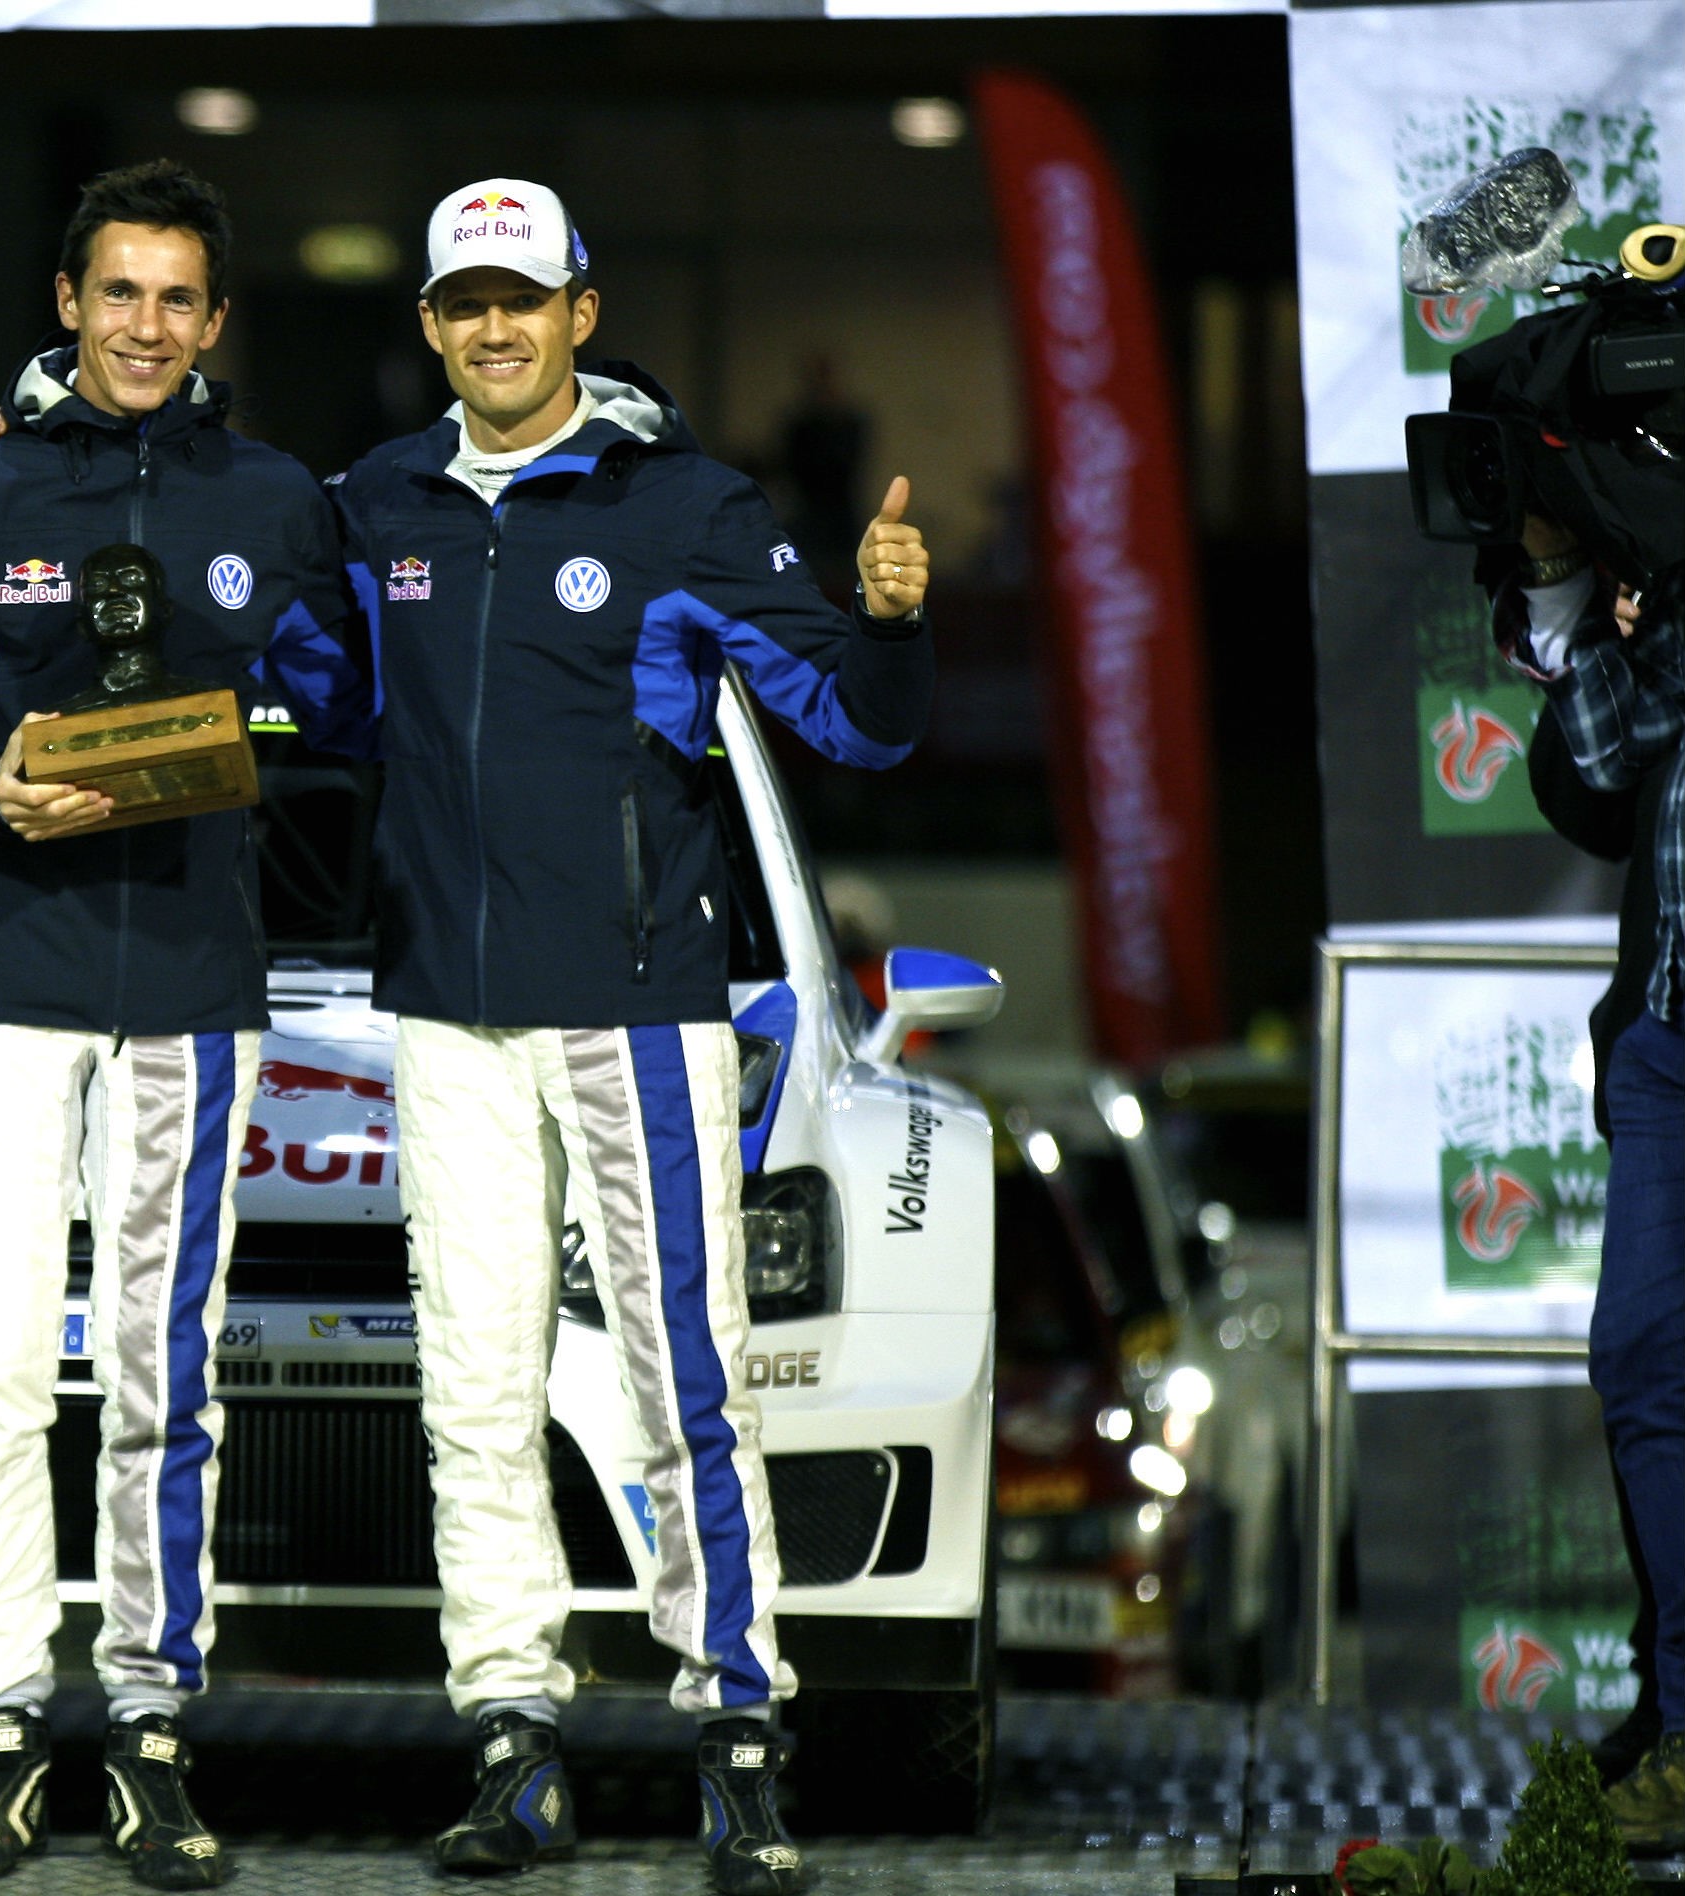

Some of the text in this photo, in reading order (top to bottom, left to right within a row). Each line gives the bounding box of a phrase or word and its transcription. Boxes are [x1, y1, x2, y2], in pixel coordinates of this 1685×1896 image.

[453, 220, 532, 244] Red Bull
[35, 582, 71, 603] Bull
[386, 579, 431, 600] Red Bull
[238, 1124, 400, 1186] Bul
[217, 1324, 257, 1347] 69
[745, 1352, 821, 1391] DGE
[141, 1739, 177, 1758] OMP
[485, 1740, 513, 1763] OMP
[732, 1749, 765, 1765] OMP
